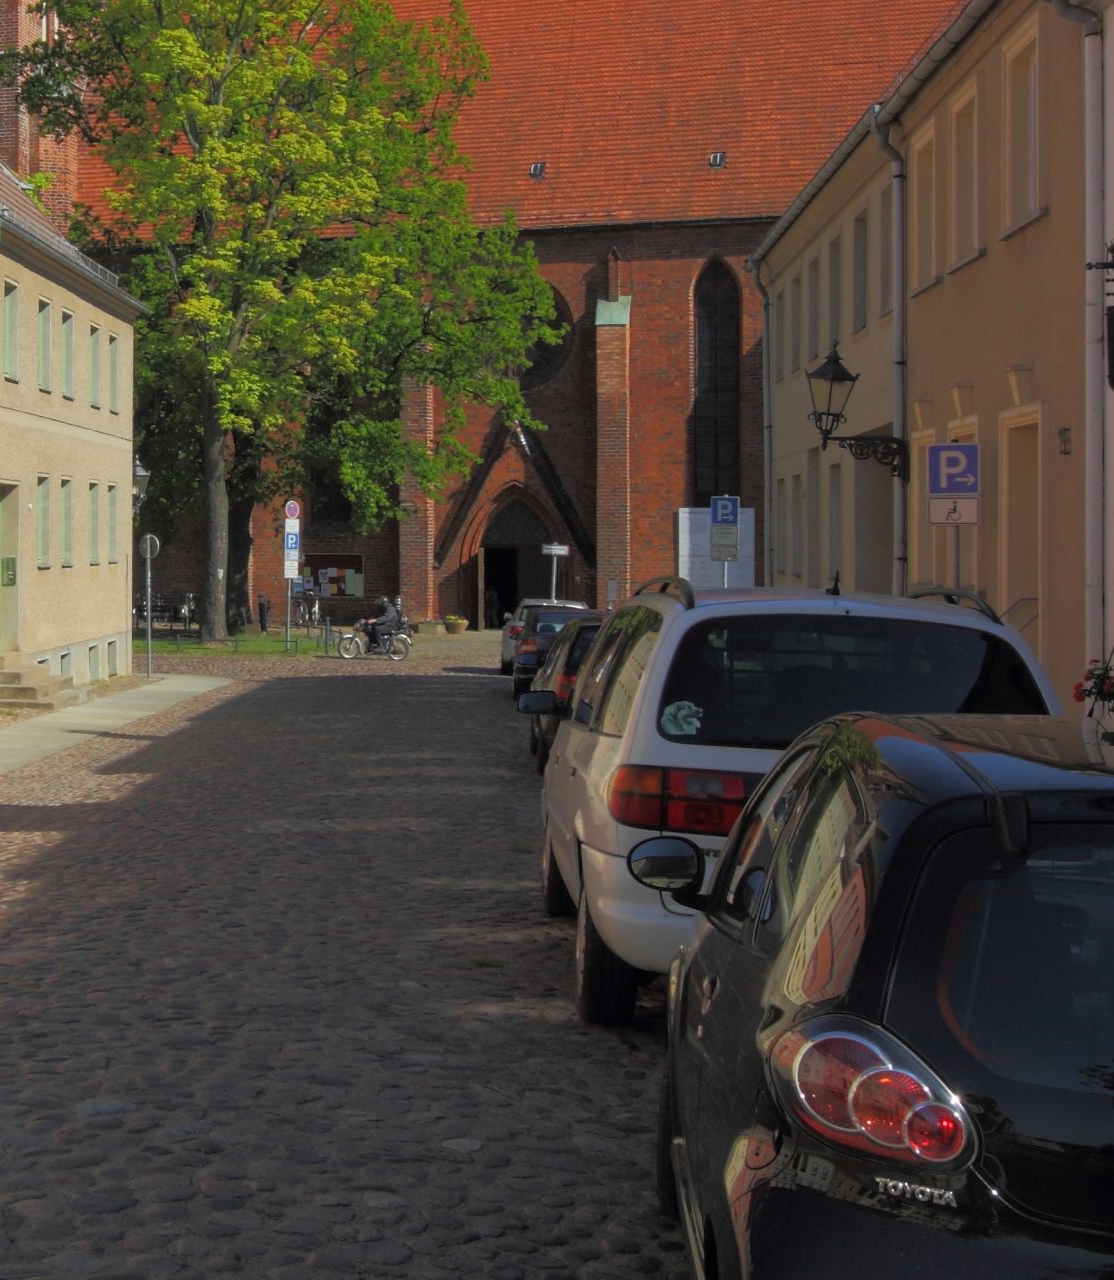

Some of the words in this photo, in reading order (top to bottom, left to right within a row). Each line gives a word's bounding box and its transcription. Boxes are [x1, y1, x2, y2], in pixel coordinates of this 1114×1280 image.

[939, 450, 967, 489] P
[717, 500, 733, 522] P
[288, 534, 296, 549] P
[874, 1176, 958, 1208] TOYOTA
